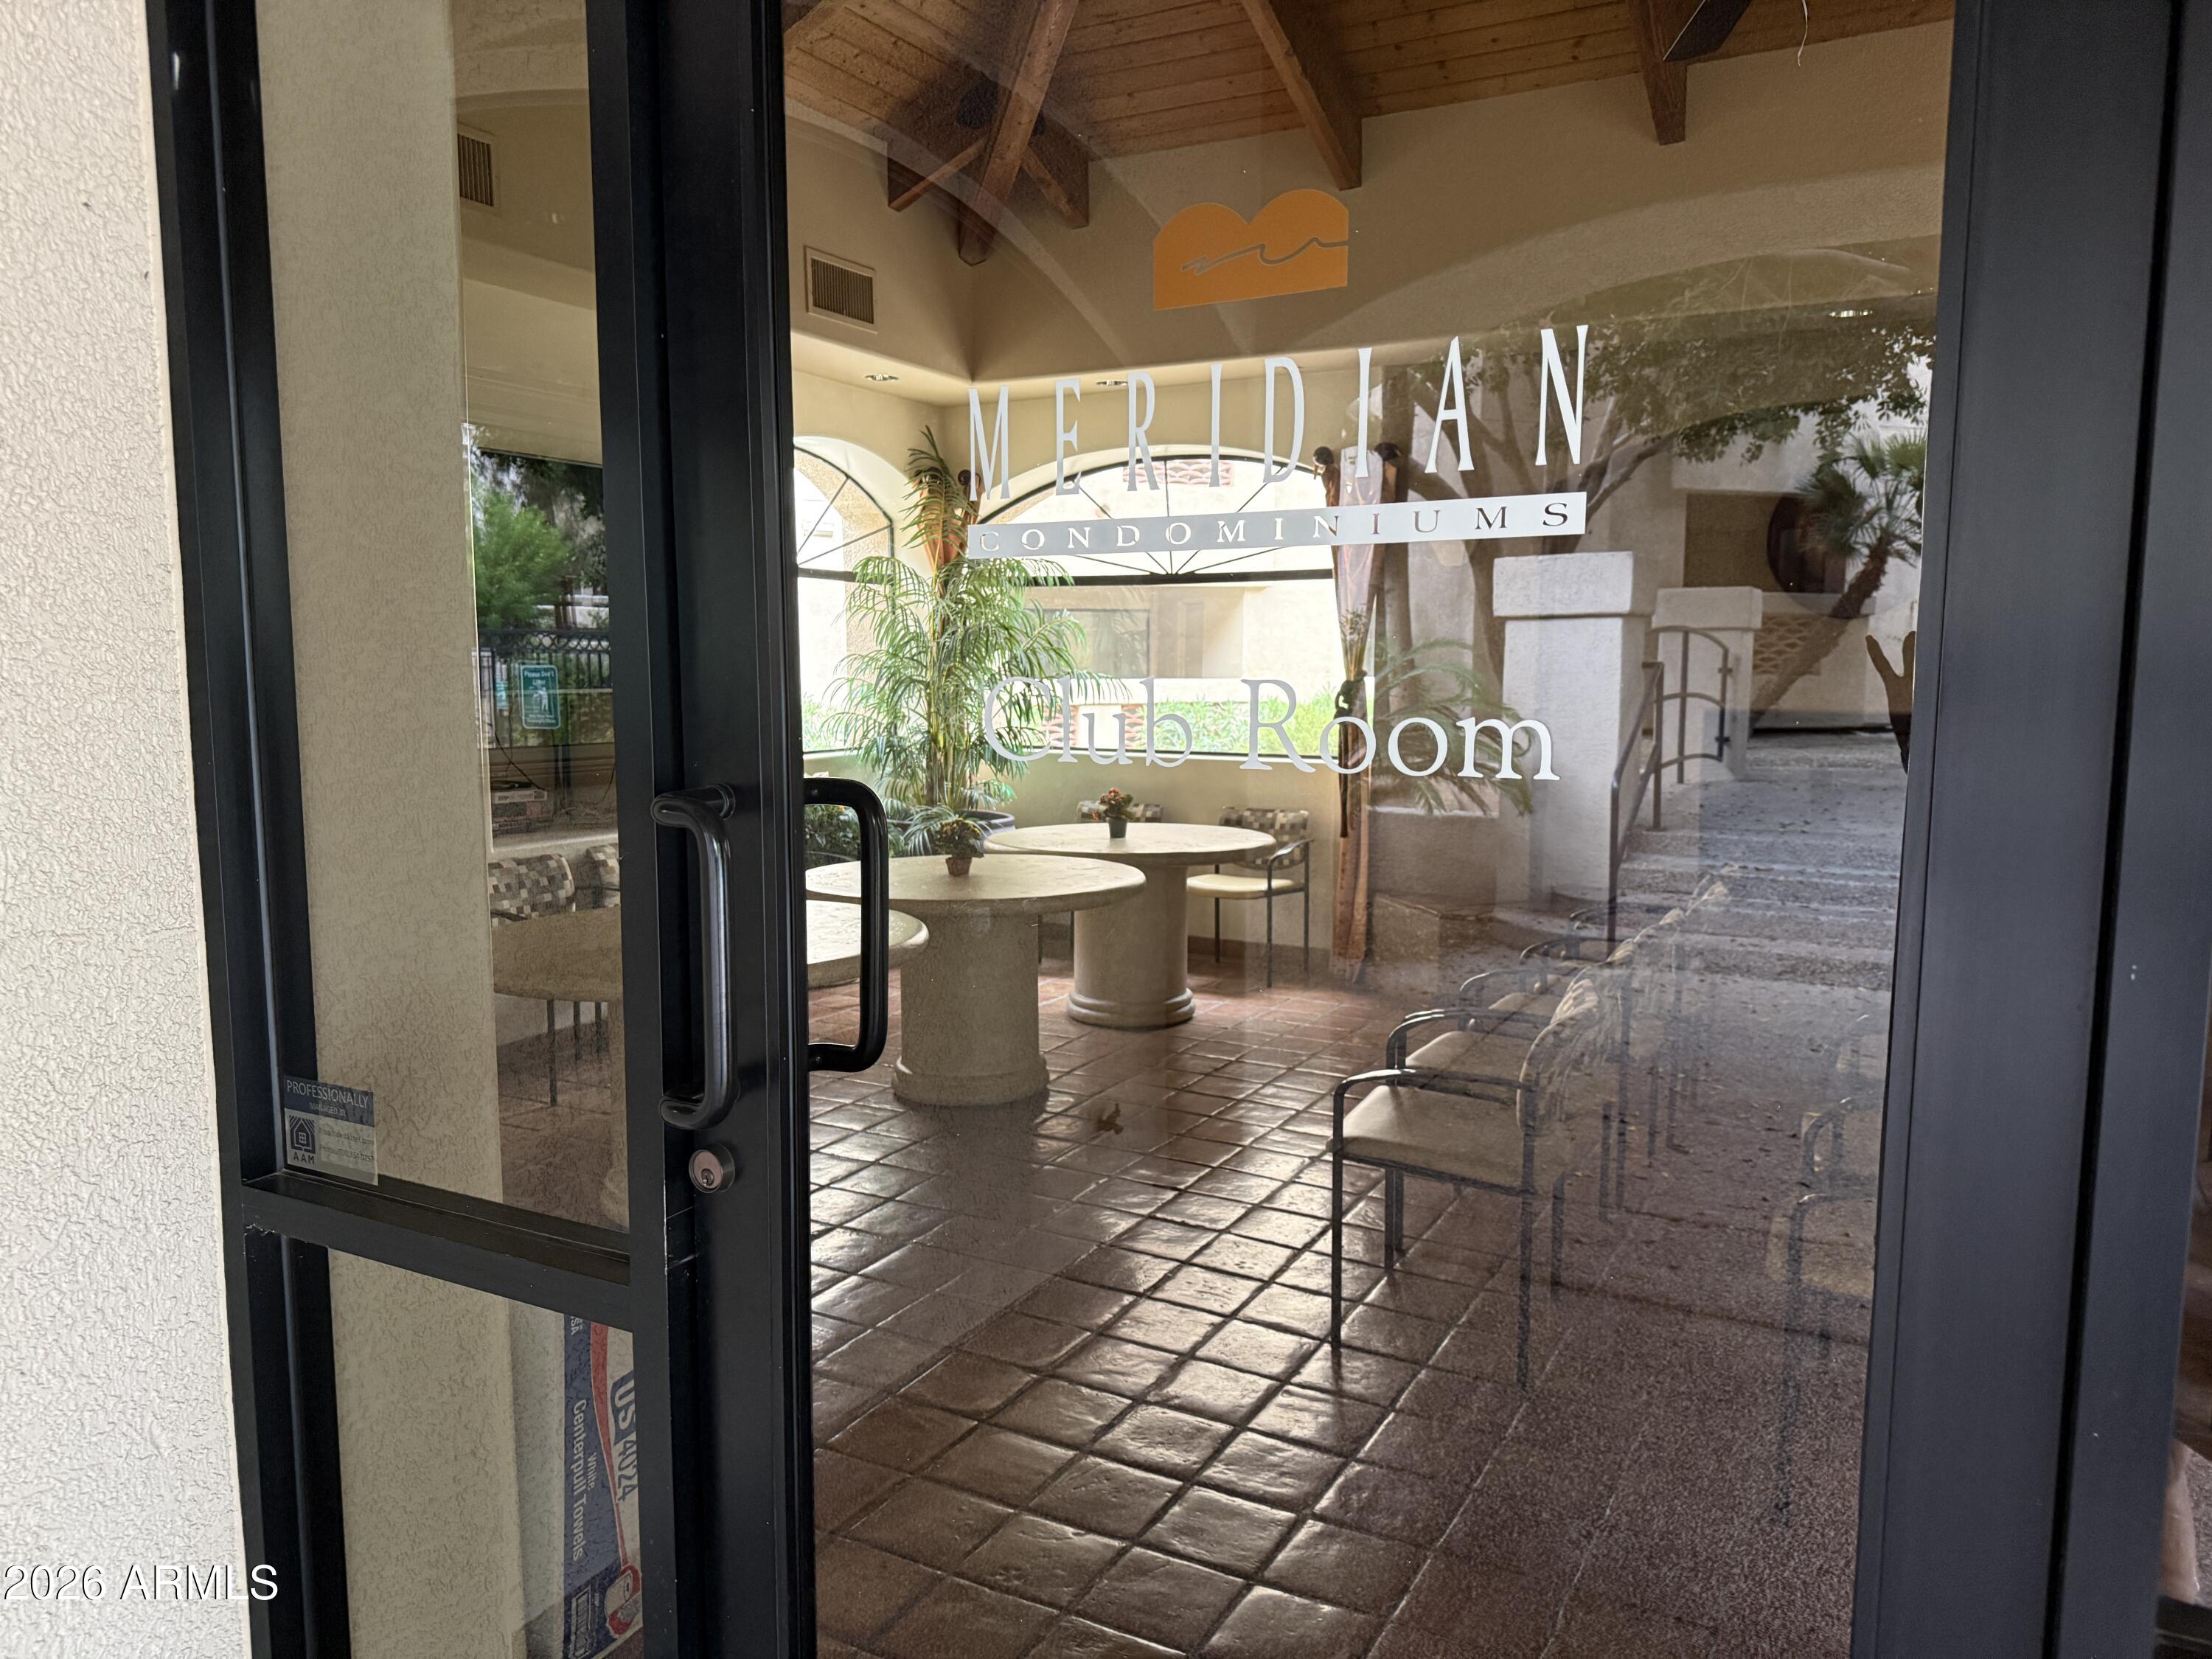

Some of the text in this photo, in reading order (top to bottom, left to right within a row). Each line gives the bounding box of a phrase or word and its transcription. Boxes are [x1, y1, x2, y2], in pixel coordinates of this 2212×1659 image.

[967, 324, 1588, 501] MERIDIAN
[980, 501, 1569, 552] CONDOMINIUMS
[983, 675, 1560, 781] Club Room
[287, 1079, 369, 1108] PROFESSIONALLY
[293, 1152, 315, 1165] AAM
[571, 1399, 587, 1562] Centerpull Towels
[588, 1452, 597, 1490] White
